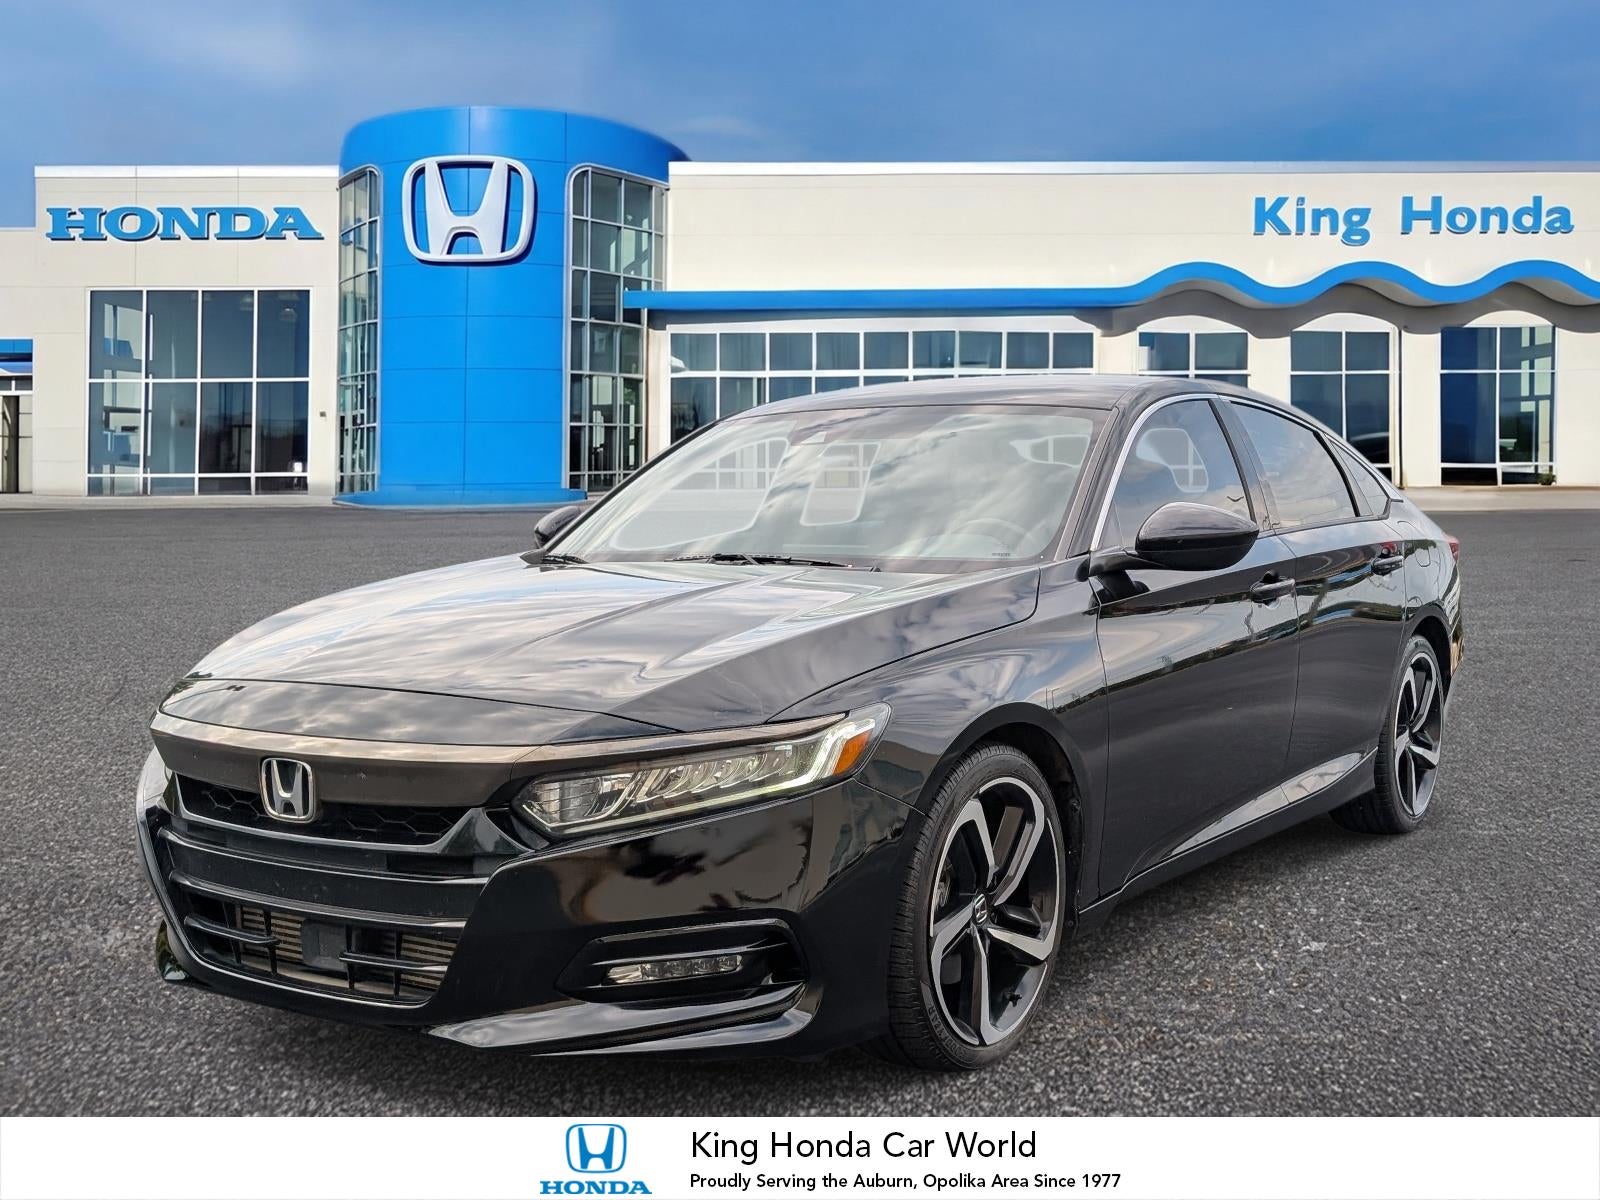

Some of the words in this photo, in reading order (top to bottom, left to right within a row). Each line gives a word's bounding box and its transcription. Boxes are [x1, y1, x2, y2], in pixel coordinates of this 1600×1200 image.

[46, 206, 323, 242] HONDA
[1253, 196, 1372, 246] King
[1401, 195, 1575, 236] Honda
